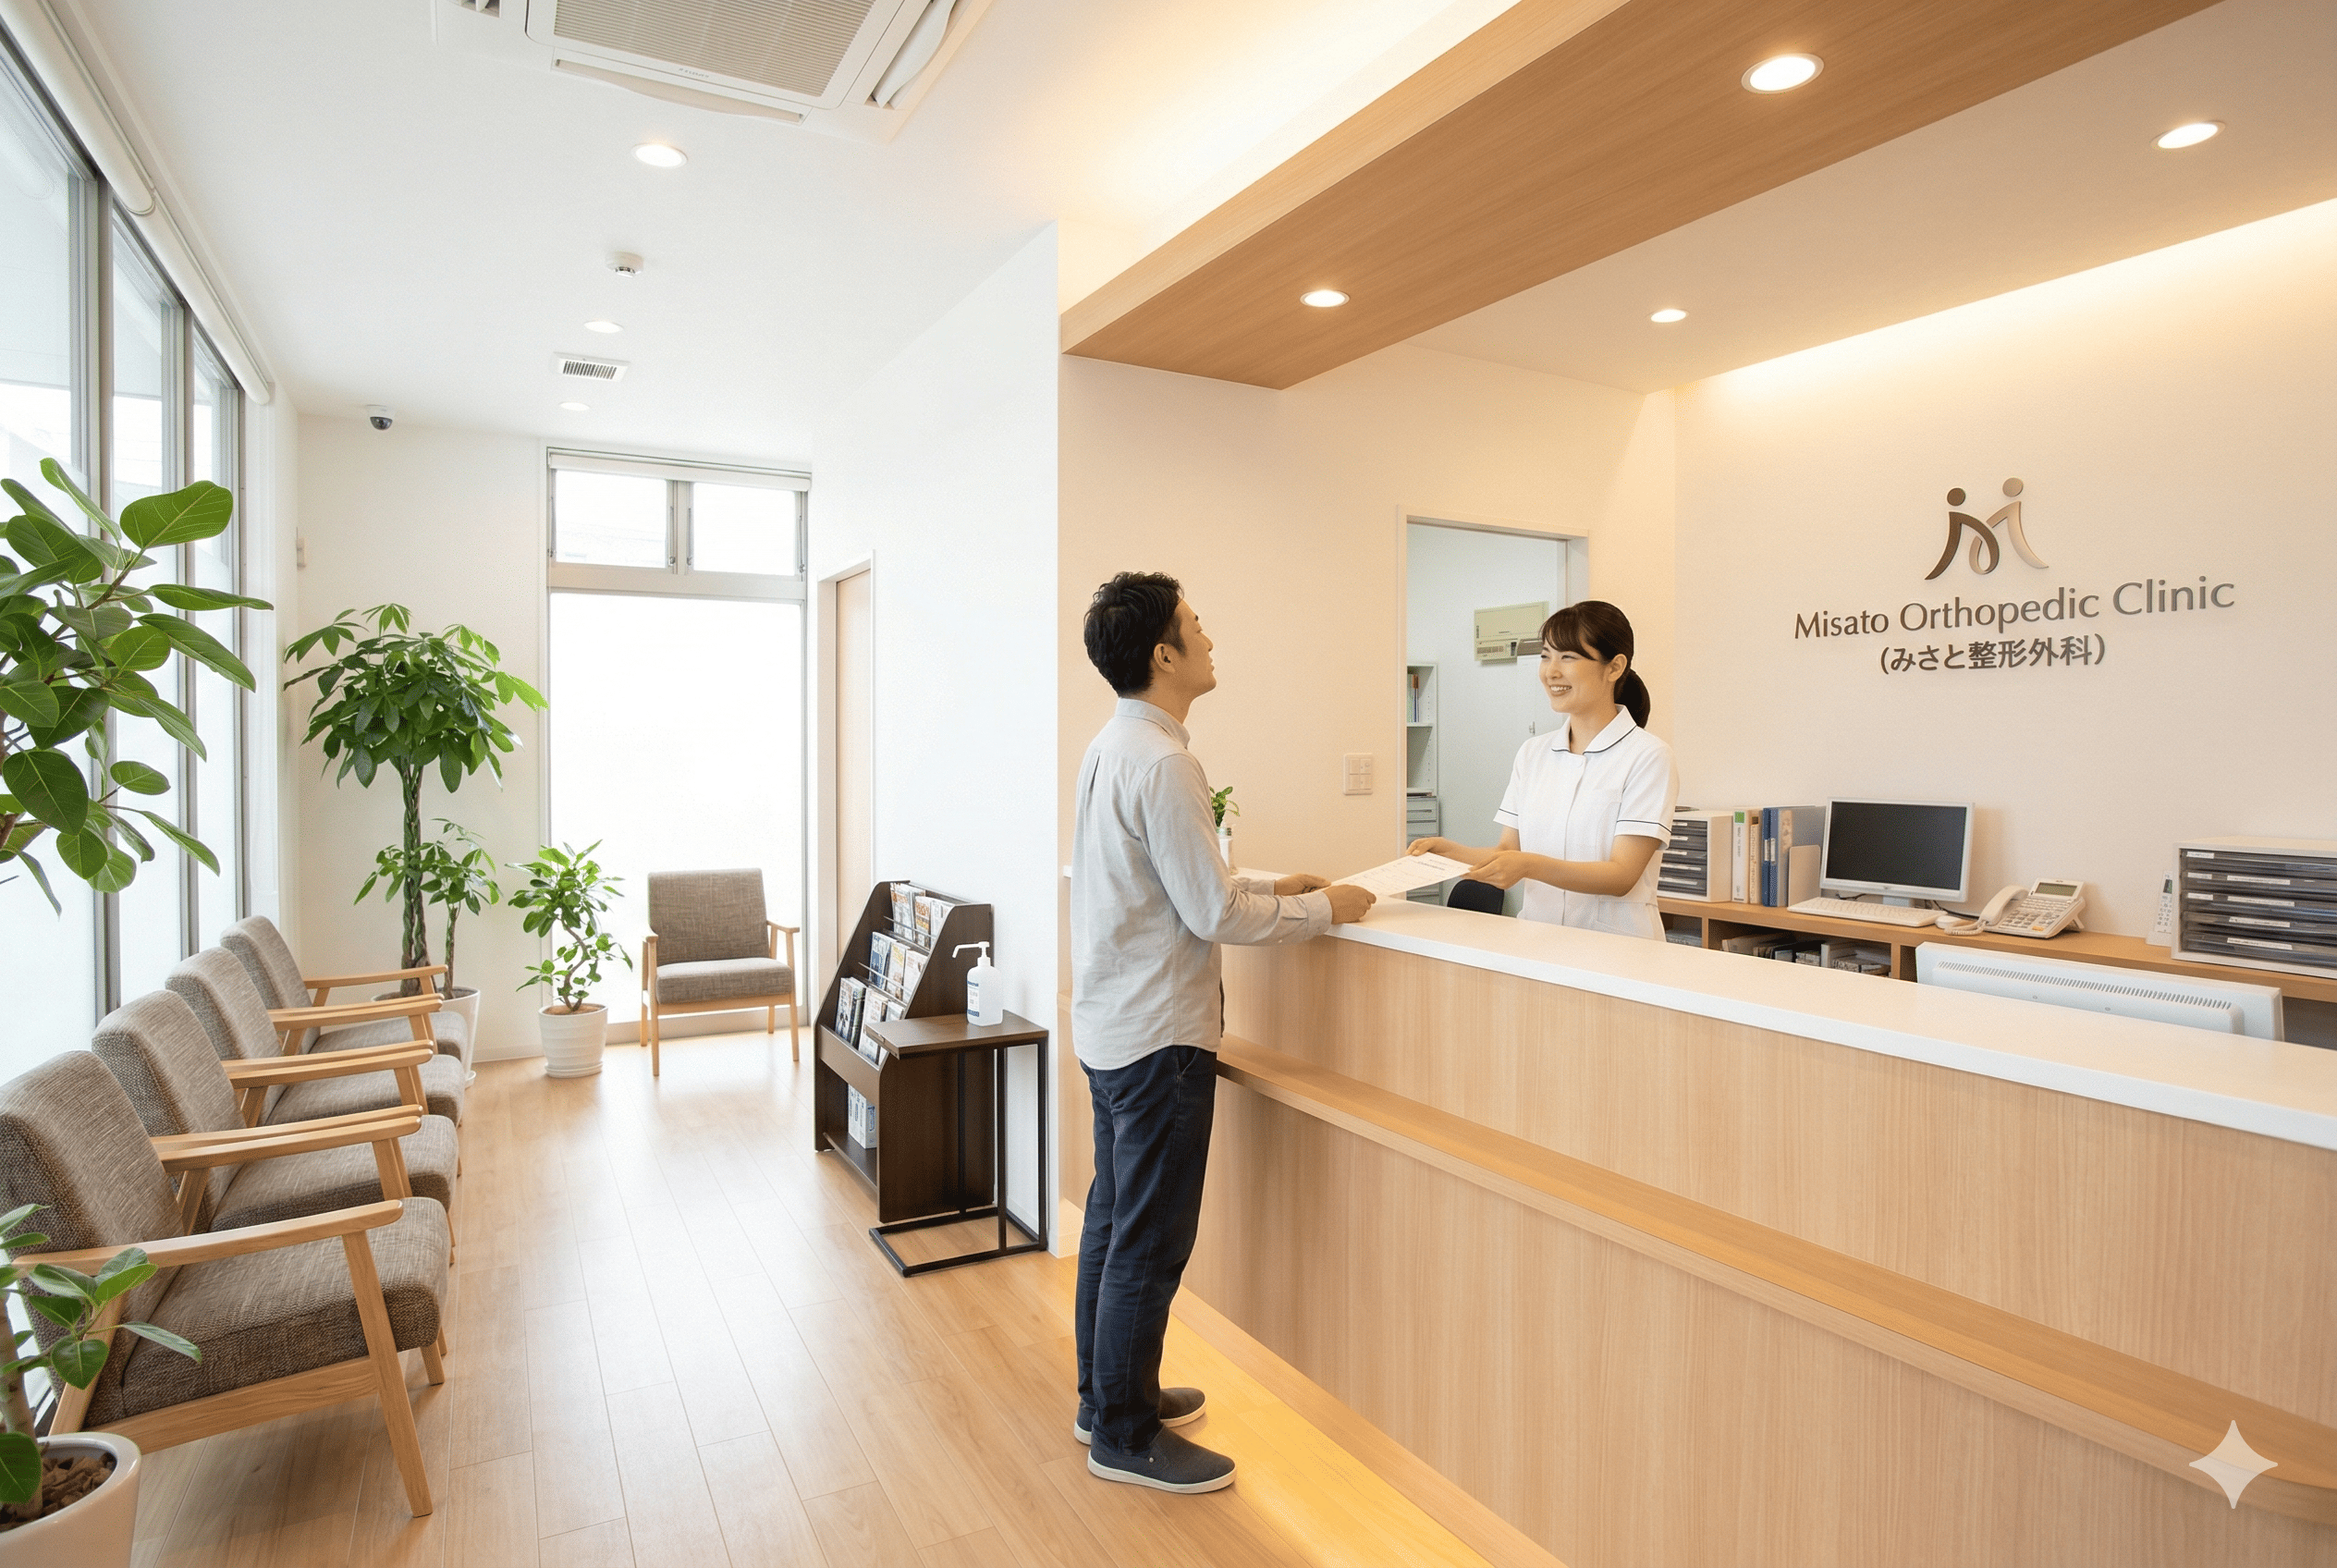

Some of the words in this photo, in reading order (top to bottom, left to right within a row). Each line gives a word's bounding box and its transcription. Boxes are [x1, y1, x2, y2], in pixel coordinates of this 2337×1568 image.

[1794, 609, 1890, 640] Misato
[1900, 586, 2100, 635] Orthopedic
[2112, 575, 2235, 616] Clinic
[1879, 633, 2106, 676] (みさと整形外科)
